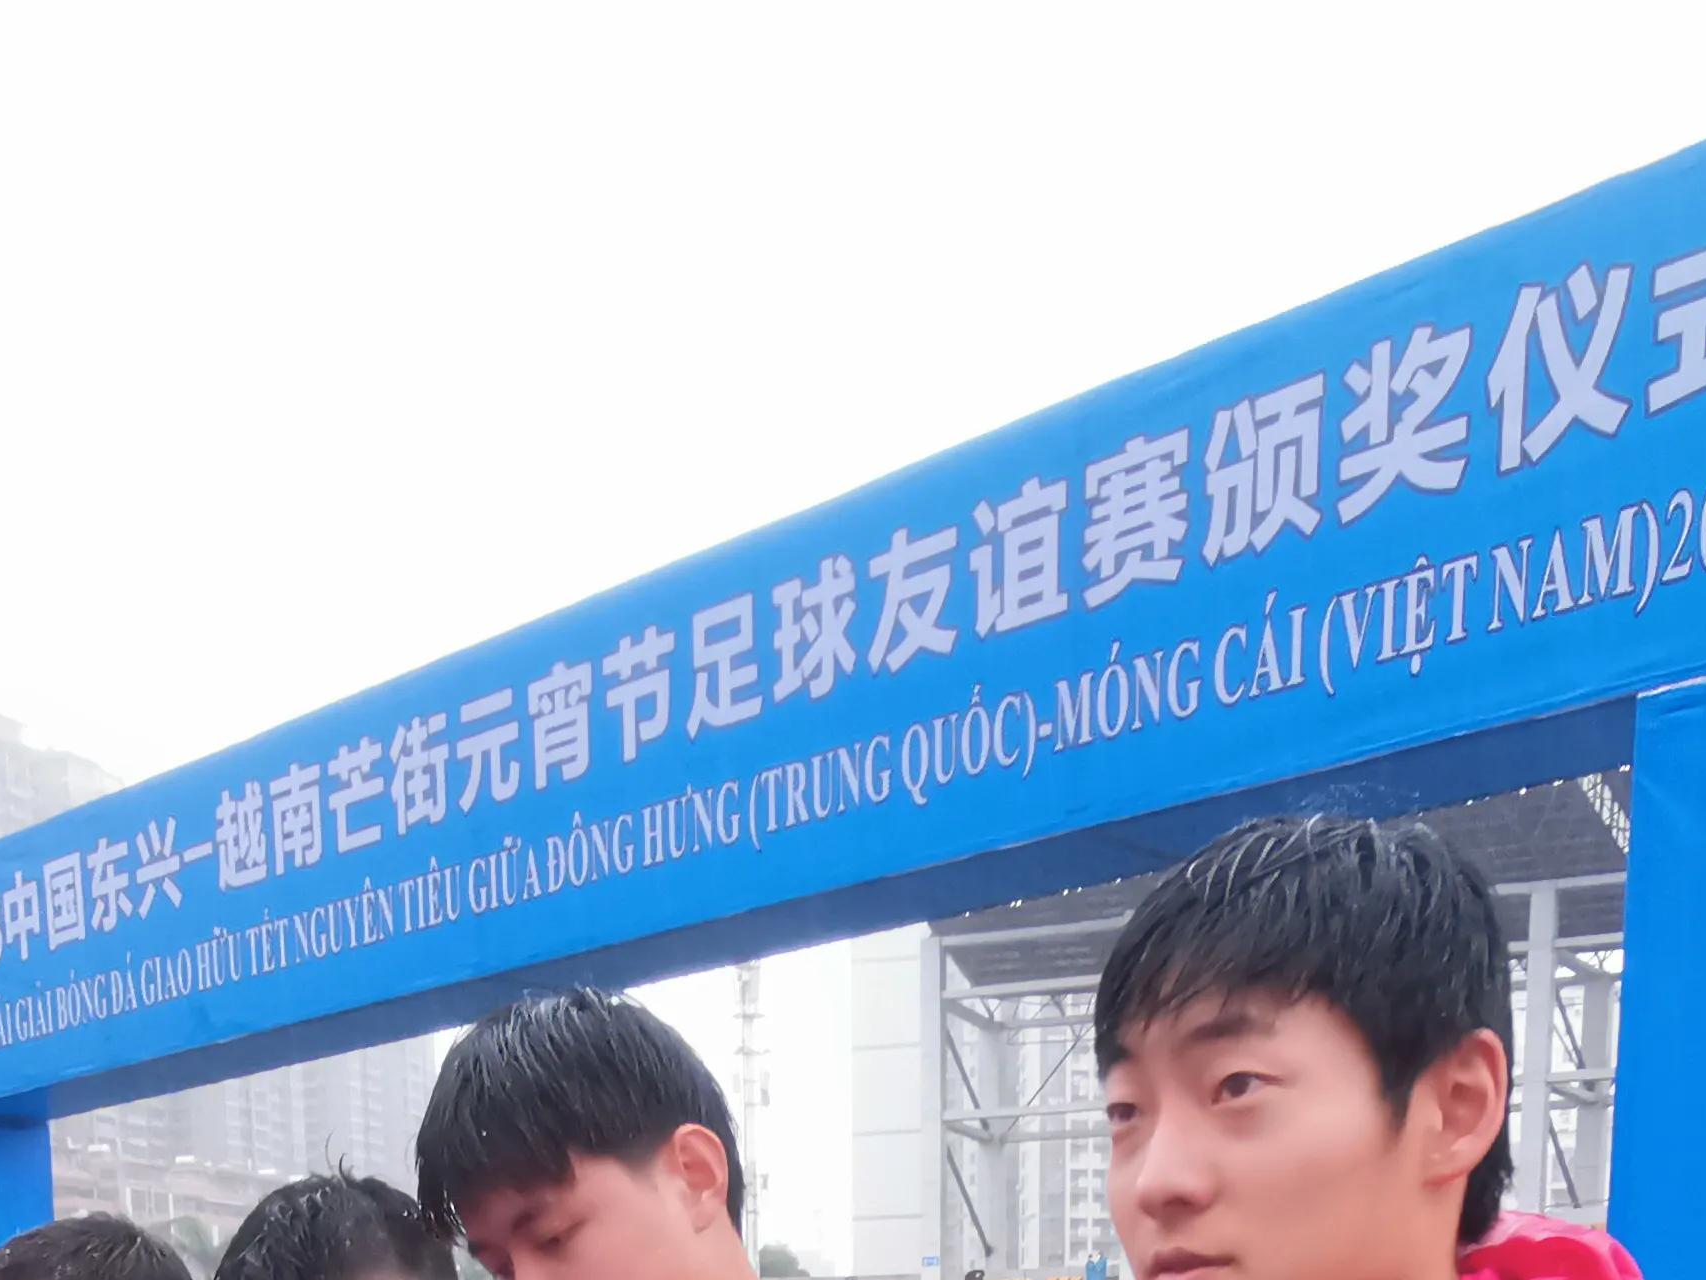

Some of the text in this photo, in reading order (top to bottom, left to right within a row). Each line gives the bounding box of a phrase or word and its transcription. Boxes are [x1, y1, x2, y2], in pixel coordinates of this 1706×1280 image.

[55, 968, 107, 1031] BÓNG
[110, 950, 139, 1016] ĐÁ
[140, 947, 192, 1006] GIAO
[195, 925, 243, 992] HỮU
[245, 907, 290, 977] TẾT
[293, 875, 395, 963] NGUYÊN
[399, 855, 462, 933] TIÊU
[545, 810, 635, 894] ĐÔNG
[642, 782, 742, 867] HƯNG
[748, 732, 892, 852] (TRUNG
[1212, 593, 1308, 707] CÁI
[1318, 535, 1478, 696] (VIỆT
